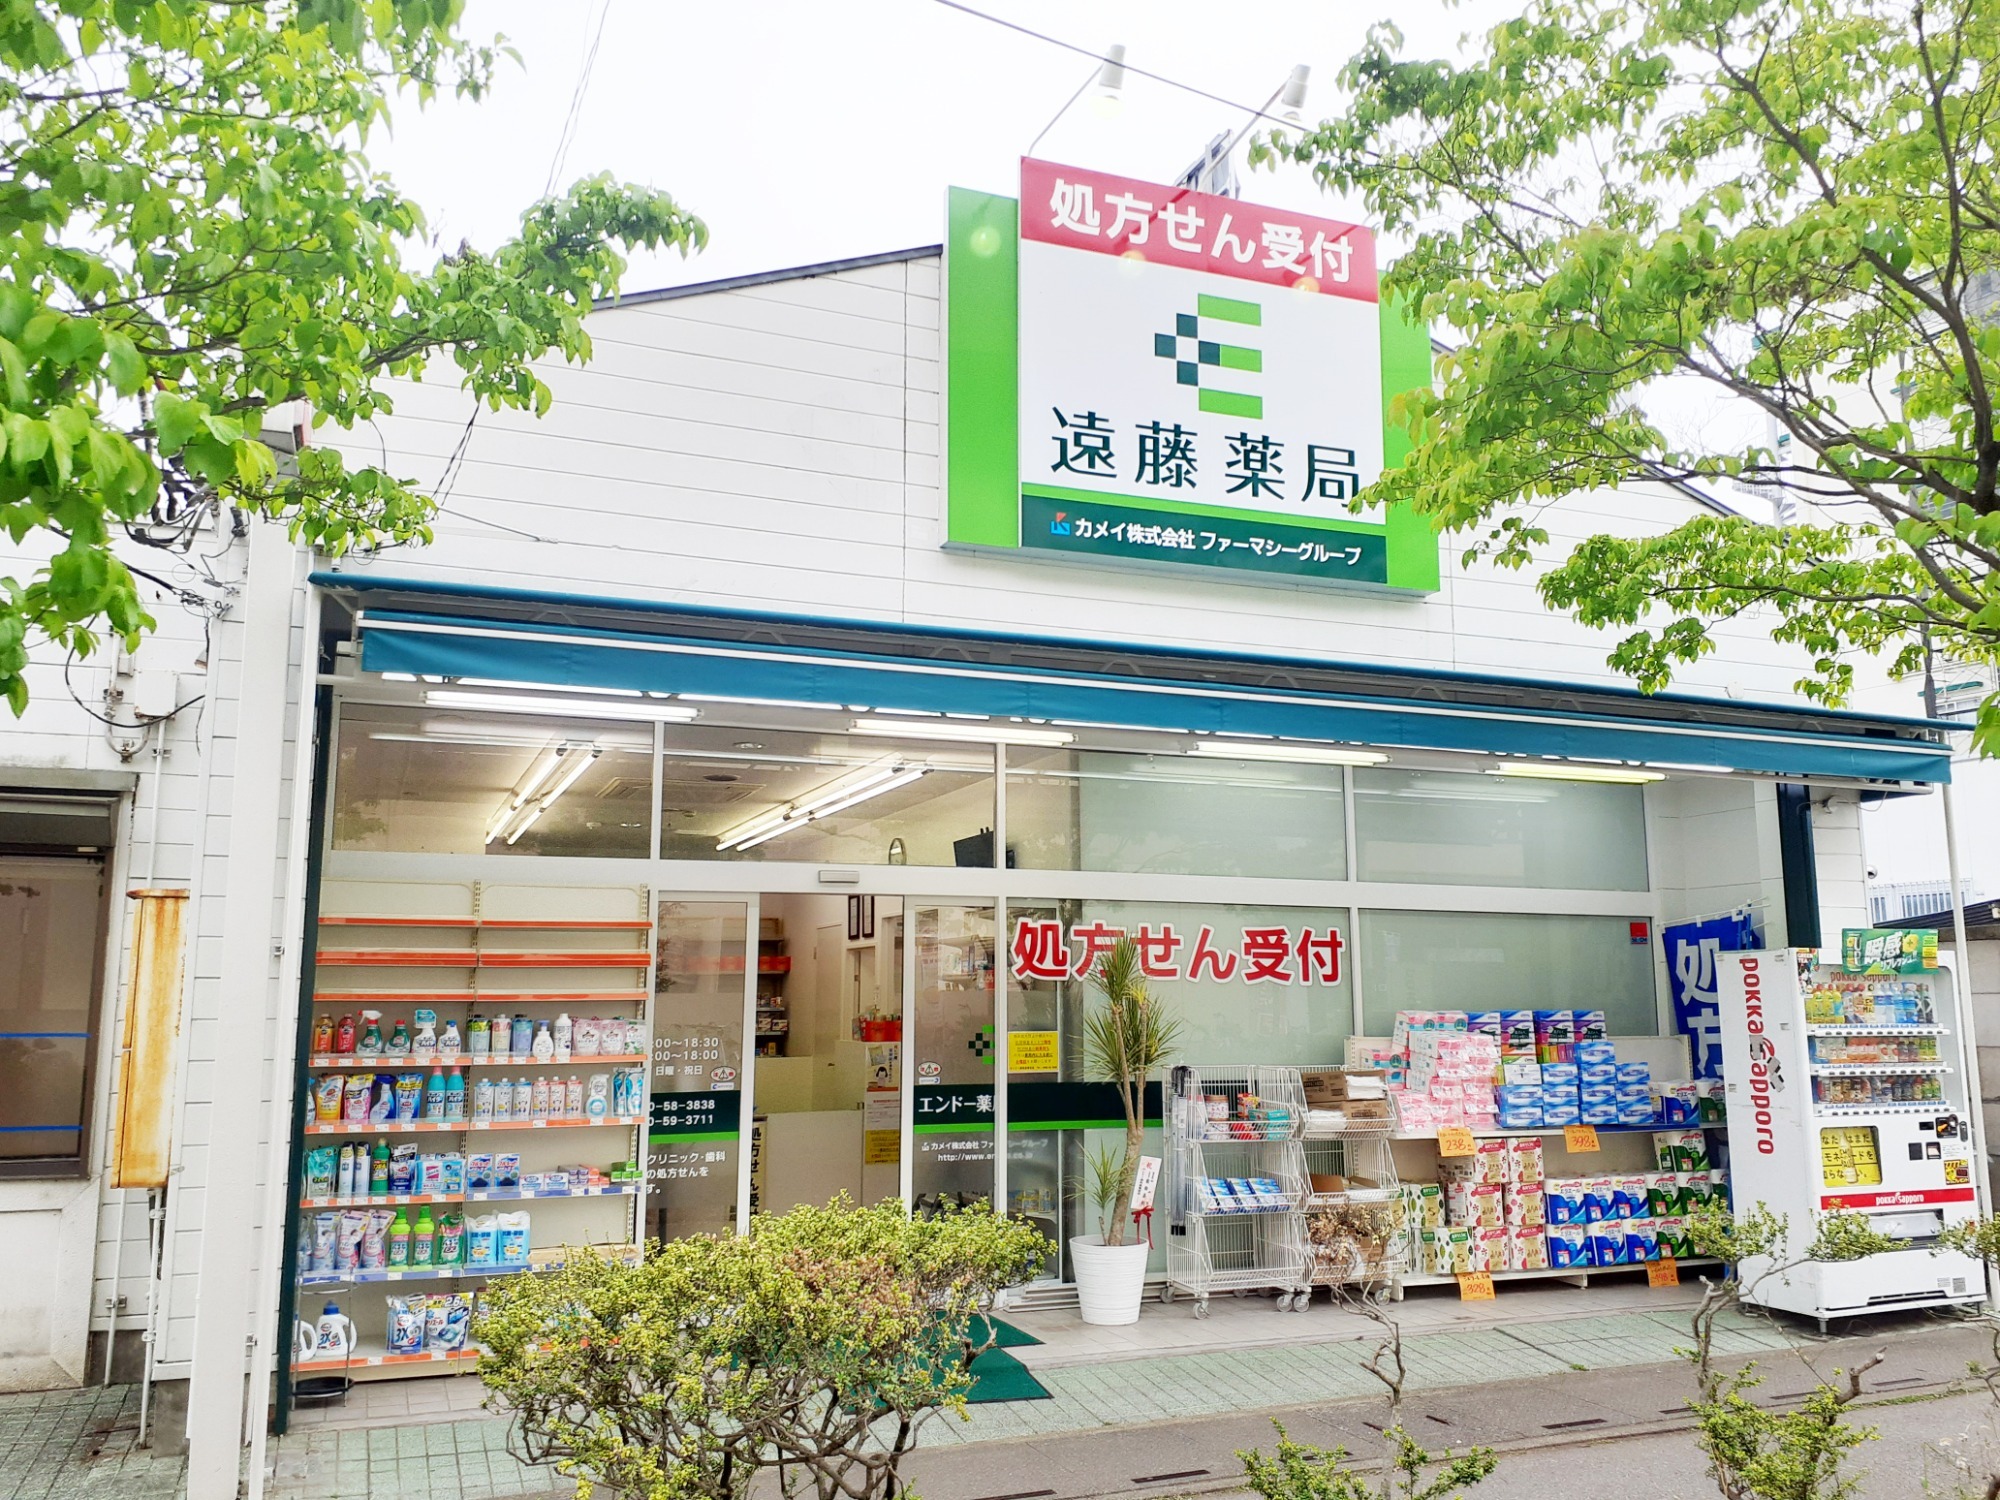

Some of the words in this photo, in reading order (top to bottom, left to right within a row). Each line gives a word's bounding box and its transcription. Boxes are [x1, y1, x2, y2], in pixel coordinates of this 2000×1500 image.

[1050, 177, 1353, 283] 処方せん受付
[1051, 406, 1360, 508] 遠藤薬局
[1075, 517, 1196, 550] カメイ株式会社
[1200, 531, 1362, 566] ファーマシーグループ
[1012, 919, 1345, 985] 処方せん受付
[918, 1094, 995, 1113] エンドー薬
